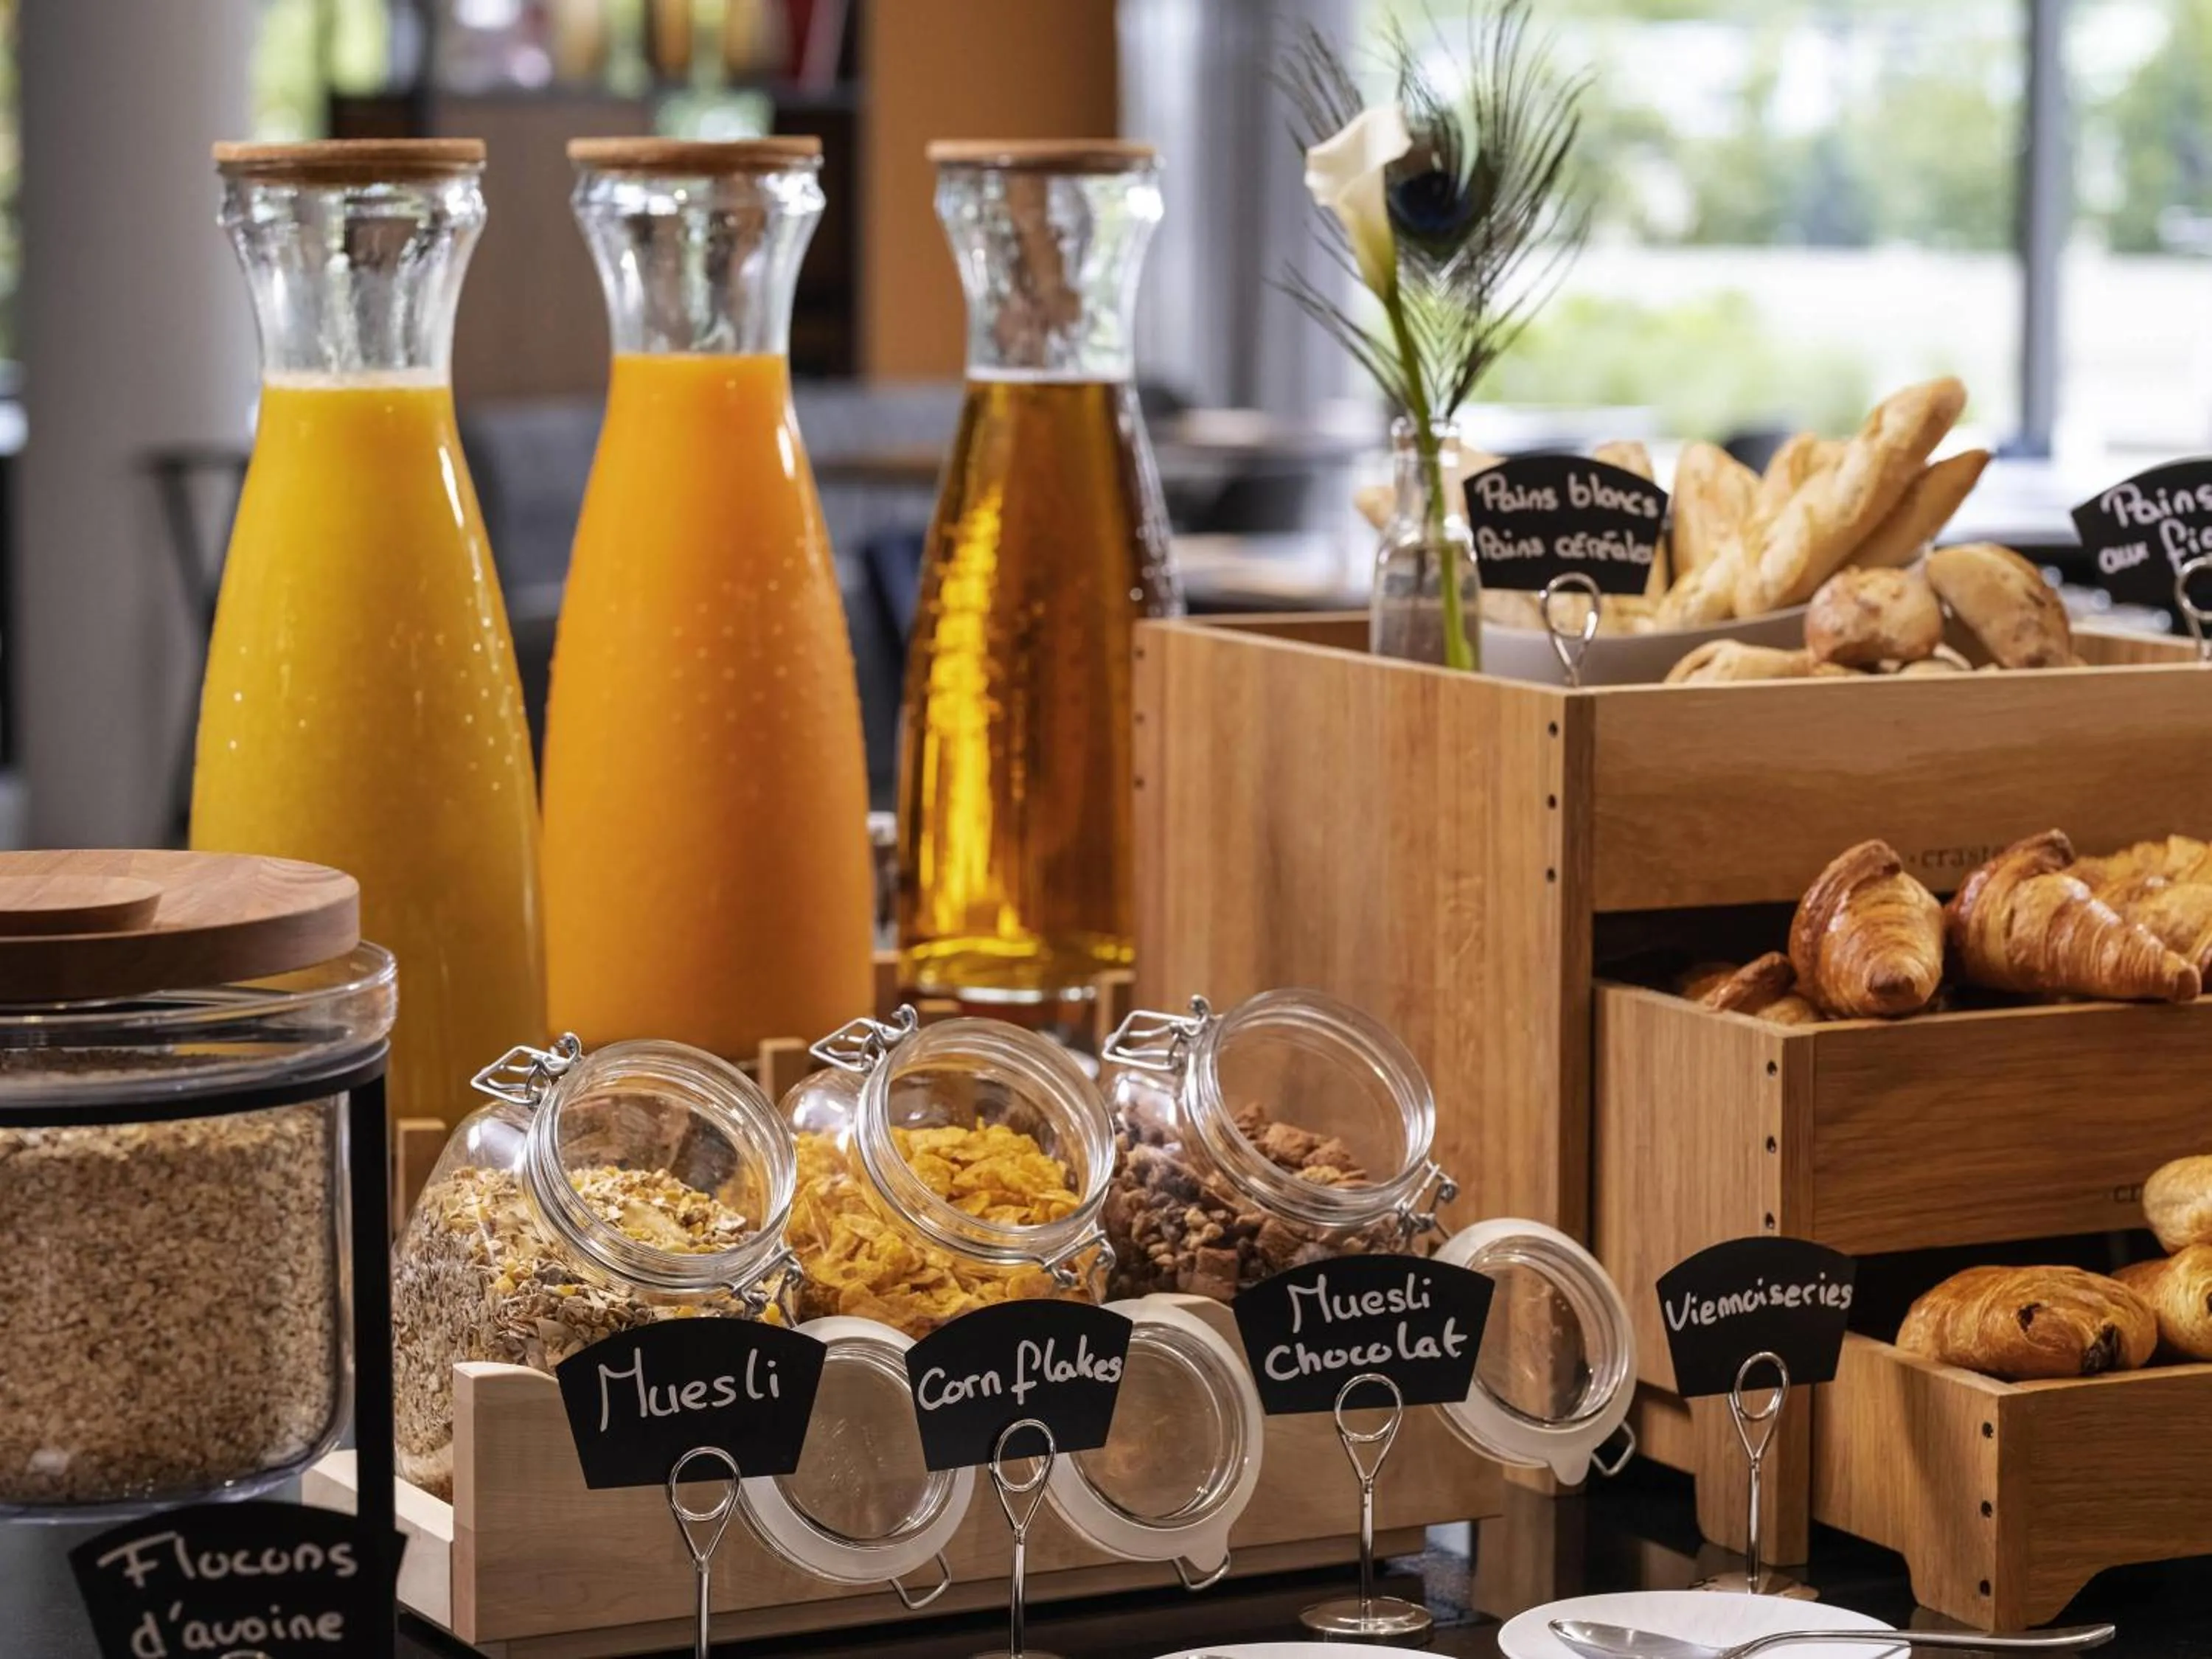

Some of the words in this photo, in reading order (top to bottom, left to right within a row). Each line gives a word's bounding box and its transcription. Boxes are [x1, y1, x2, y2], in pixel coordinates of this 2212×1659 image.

[1476, 472, 1559, 512] Pains
[1568, 472, 1658, 519] blancs
[2101, 482, 2212, 529] Pains
[1477, 526, 1545, 560] Pains
[1287, 1273, 1430, 1333] Muesli
[918, 1367, 1002, 1411] Corn
[1011, 1334, 1122, 1405] flakes
[1265, 1317, 1467, 1380] Chocolat
[599, 1347, 779, 1432] Muesli
[97, 1531, 358, 1587] Flocons
[131, 1601, 344, 1659] d'avoine
